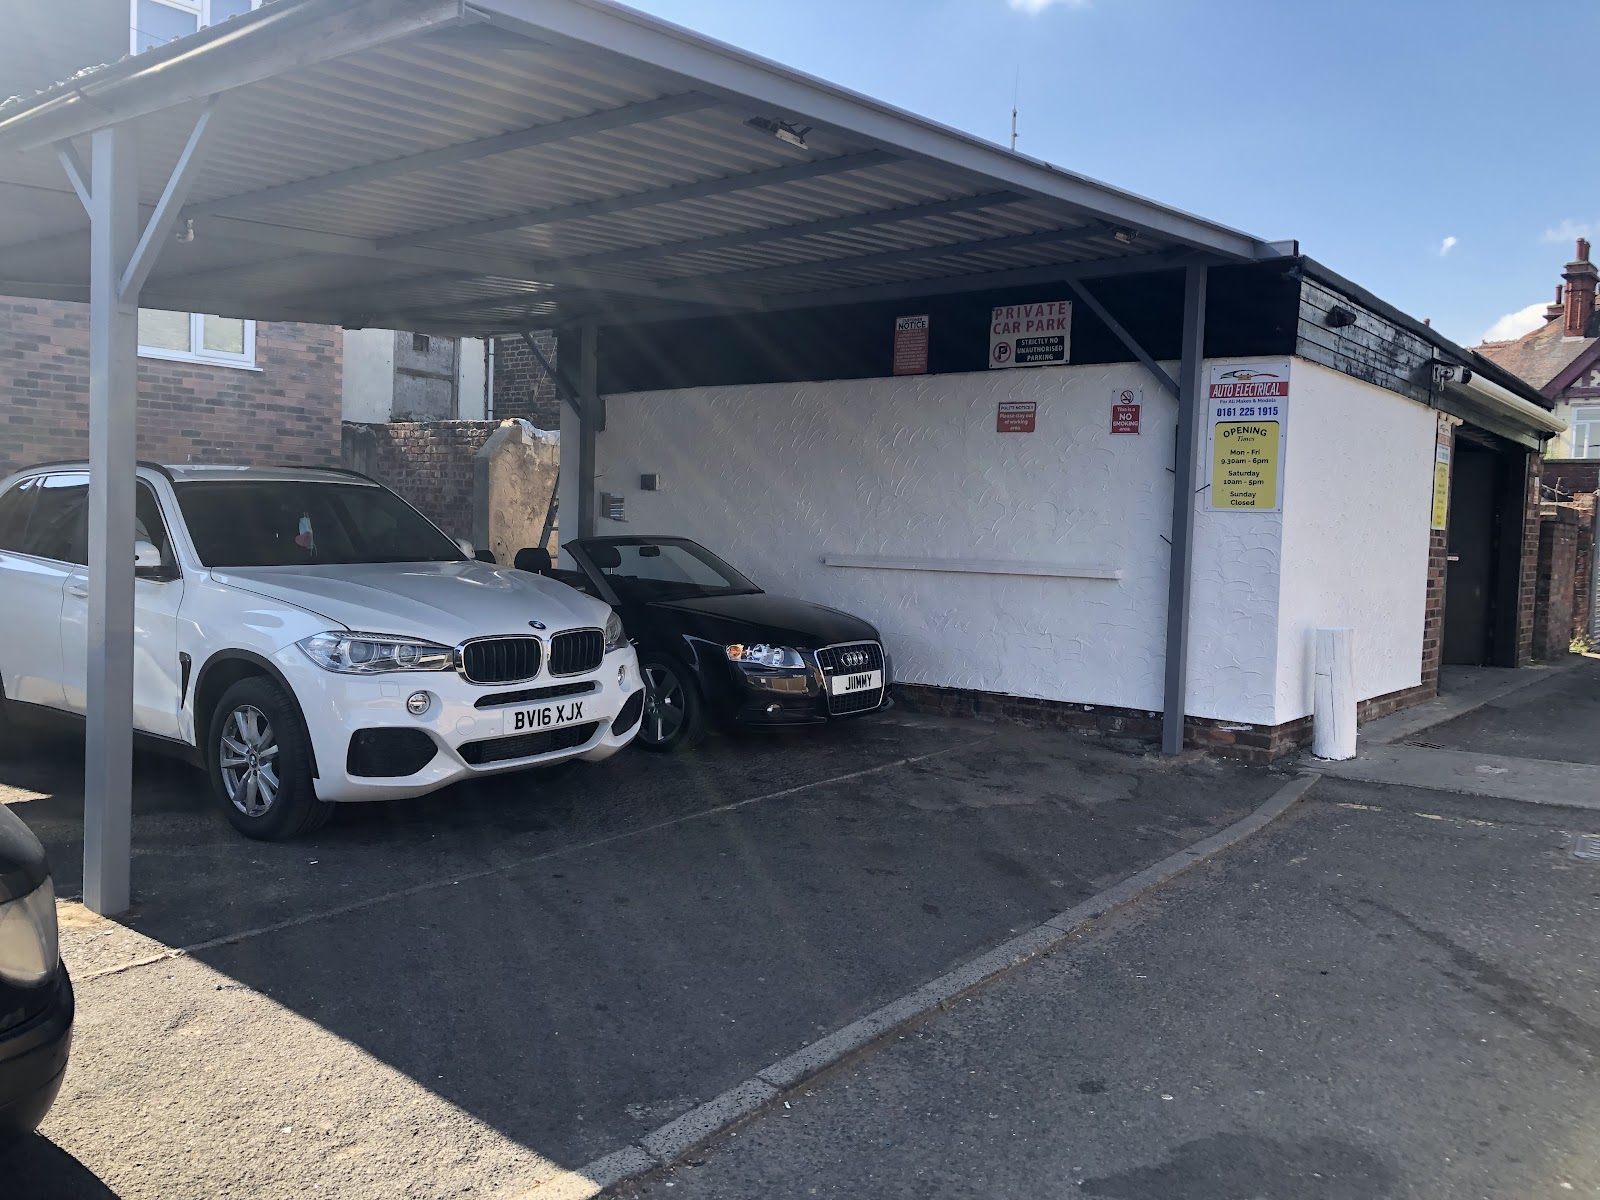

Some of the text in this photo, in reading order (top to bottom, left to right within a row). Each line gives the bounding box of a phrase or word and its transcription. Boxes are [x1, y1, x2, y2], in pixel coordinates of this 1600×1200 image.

[994, 302, 1067, 320] PRIVATE
[898, 320, 926, 330] NOTICE
[992, 317, 1066, 335] CAR PARK
[1021, 338, 1049, 346] STRICTLY
[1017, 345, 1063, 354] UNAUTHORISED
[1026, 354, 1054, 362] PARKING
[1212, 383, 1280, 397] AUTO ELECTRICAL
[1216, 406, 1279, 417] 0161 225 1915
[1119, 412, 1132, 421] NO
[1223, 426, 1268, 438] OPENING
[1251, 448, 1261, 456] Fri
[1252, 457, 1269, 465] 6pm
[1228, 470, 1261, 478] Saturday
[1229, 491, 1257, 499] Sunday
[514, 701, 583, 730] BV16 XJX
